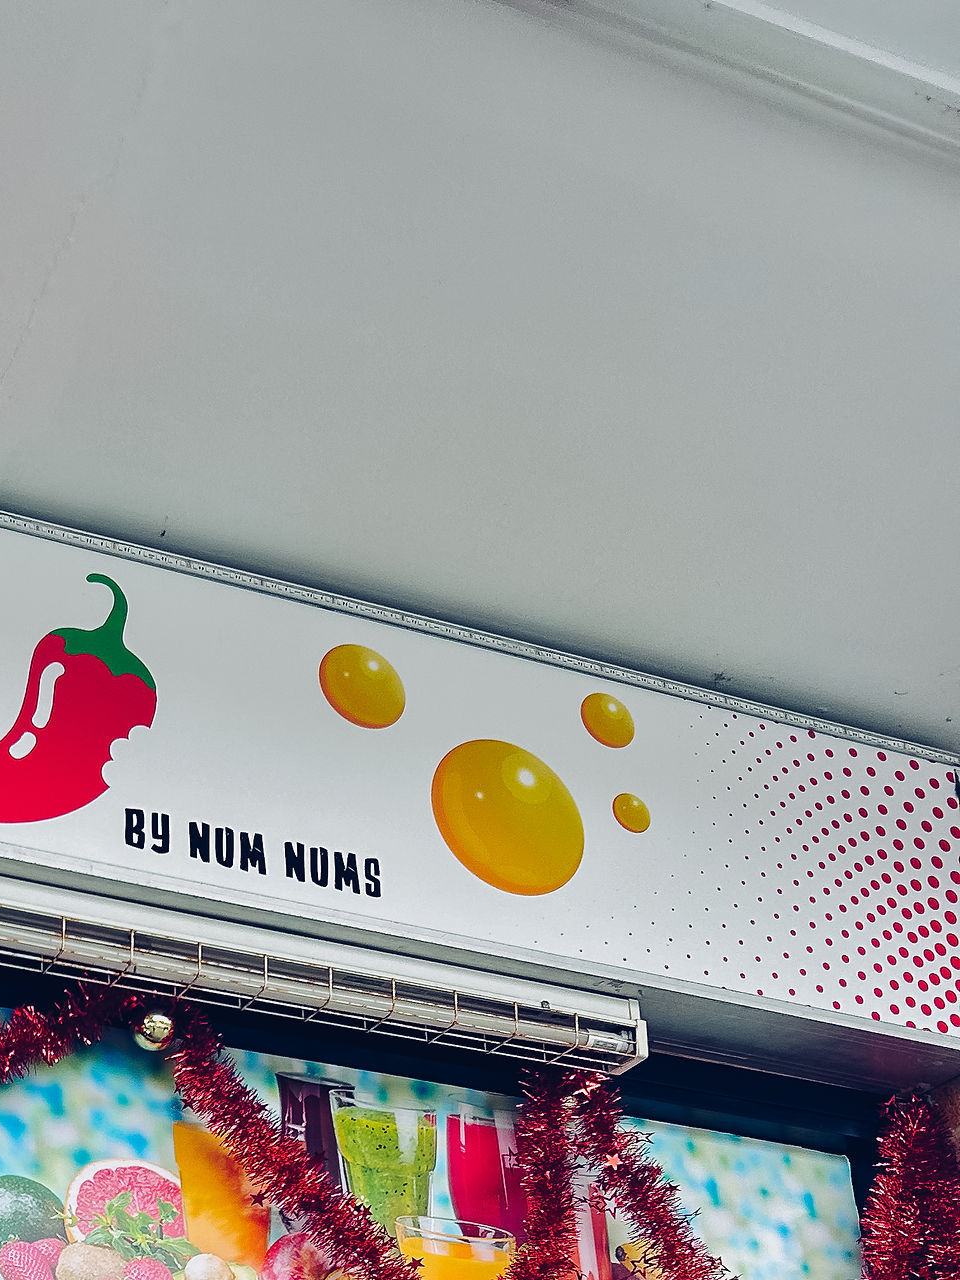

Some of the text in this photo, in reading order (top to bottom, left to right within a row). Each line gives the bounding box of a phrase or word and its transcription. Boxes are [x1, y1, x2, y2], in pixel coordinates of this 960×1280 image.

[123, 807, 383, 899] BY NUM NUMS
